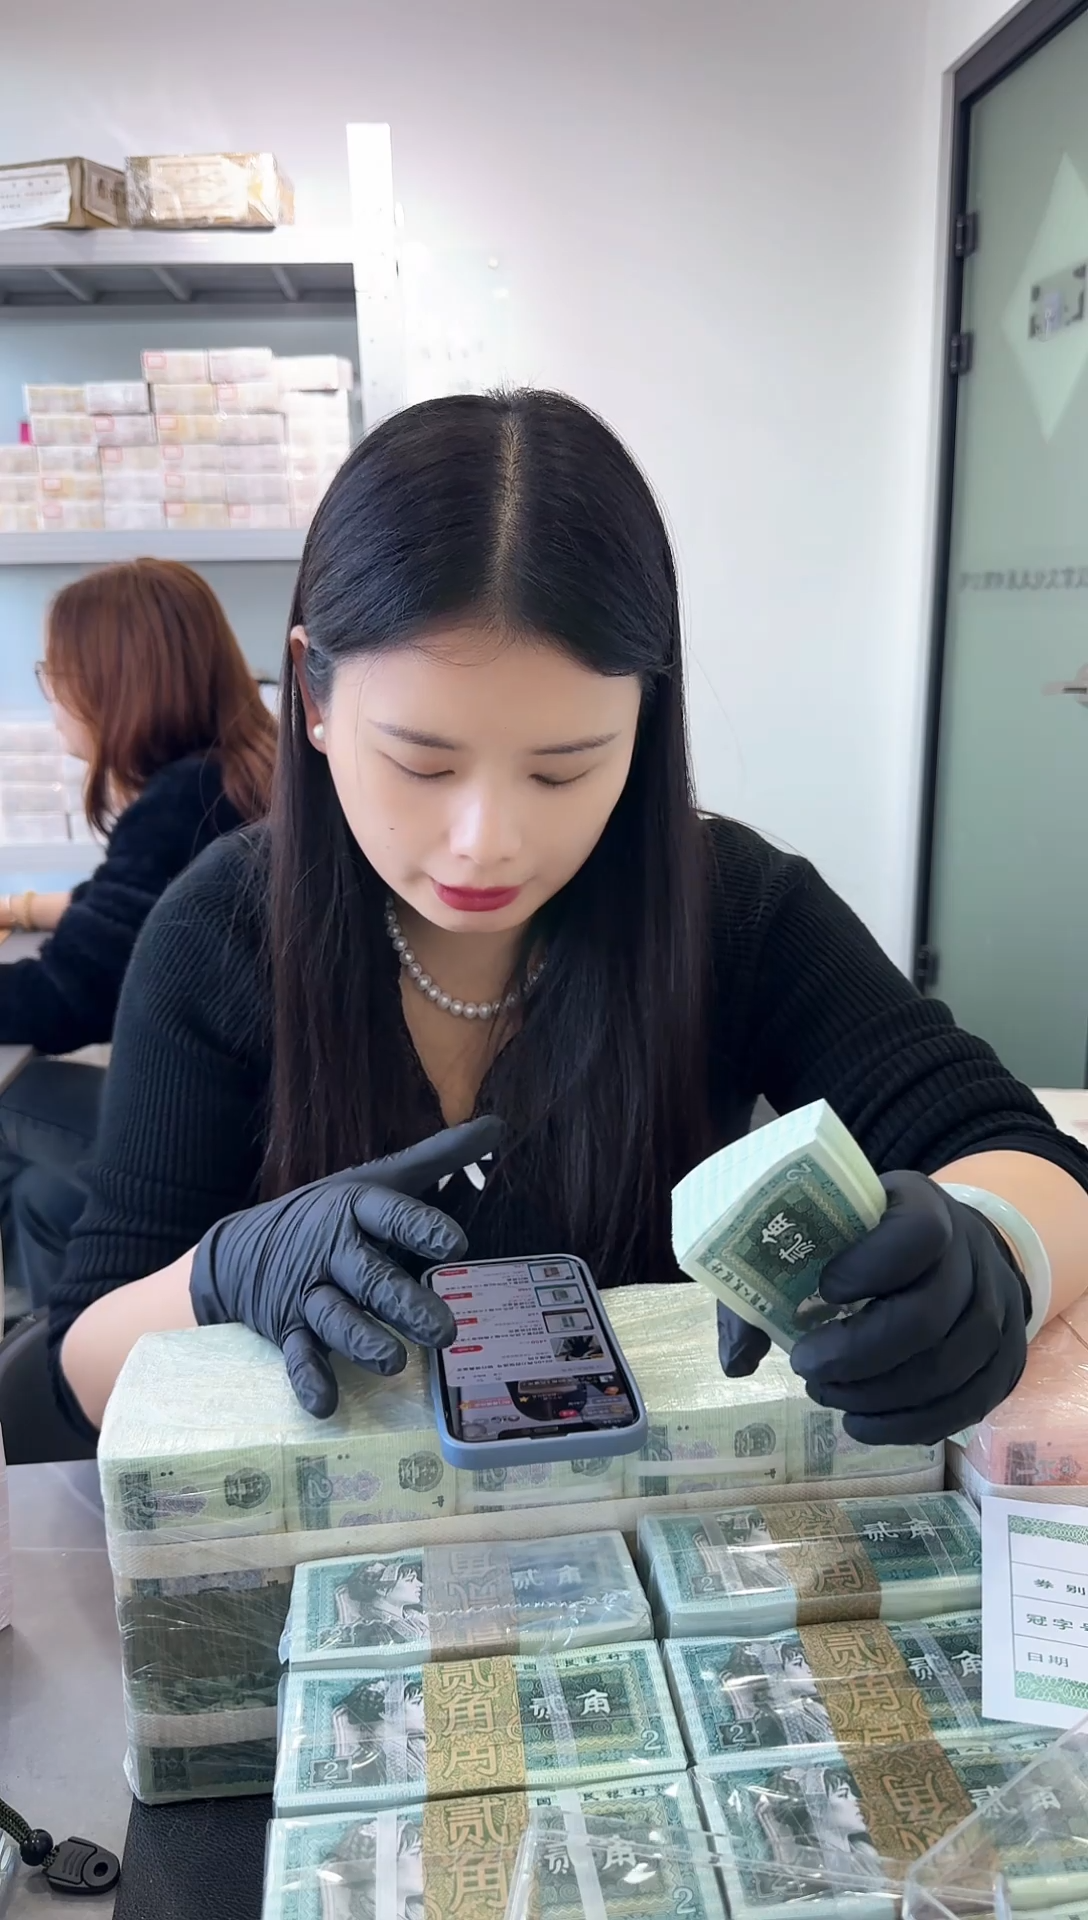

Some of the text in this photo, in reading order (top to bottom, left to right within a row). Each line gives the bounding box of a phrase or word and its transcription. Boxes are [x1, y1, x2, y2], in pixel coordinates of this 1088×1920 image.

[761, 1212, 816, 1264] 贰角
[711, 1262, 772, 1313] 中国人民银行
[862, 1517, 937, 1542] 贰角
[512, 1564, 582, 1590] 贰角
[701, 1577, 715, 1591] 2
[1027, 1652, 1069, 1668] 日期
[529, 1689, 611, 1719] 贰角
[642, 1730, 661, 1751] 2
[730, 1724, 747, 1743] 2
[324, 1762, 338, 1780] 2
[673, 1886, 697, 1915] 2
